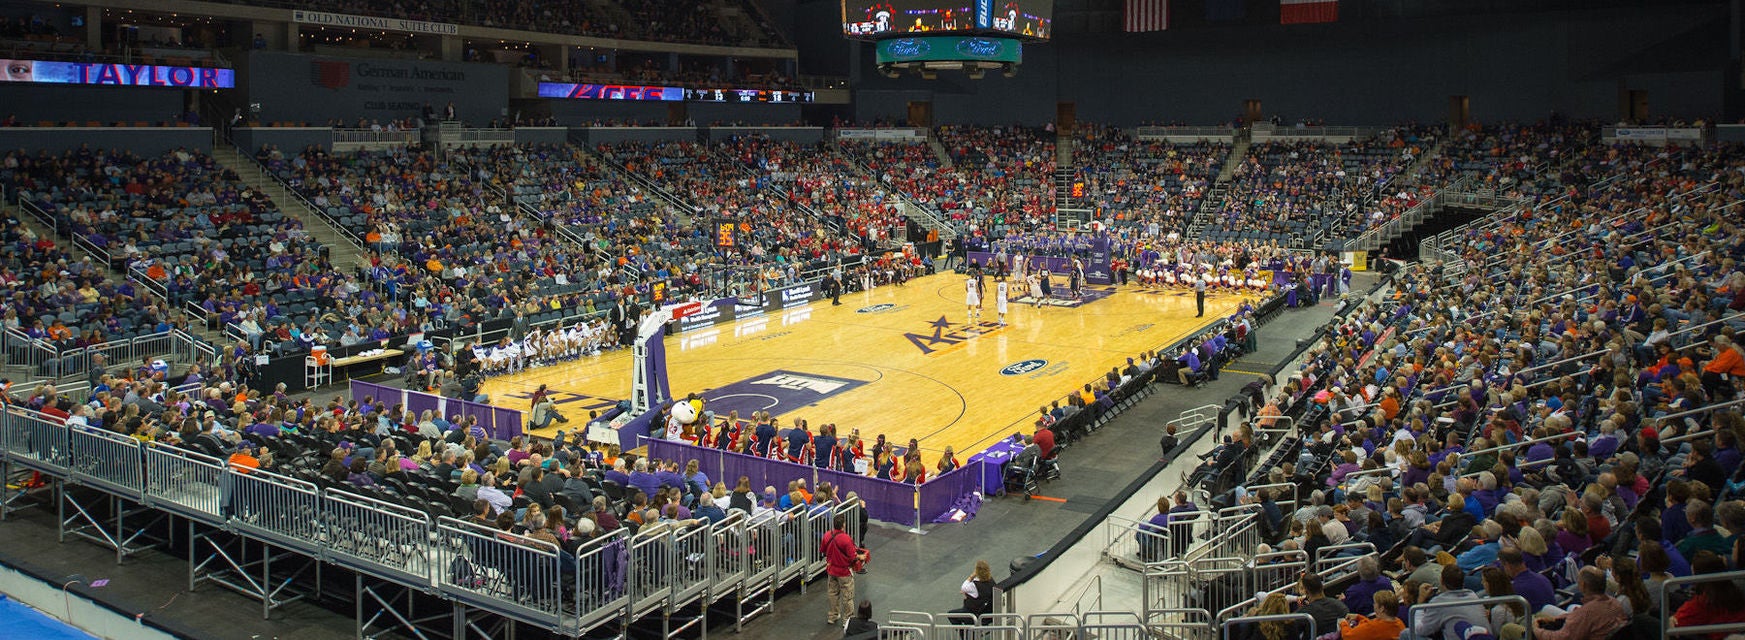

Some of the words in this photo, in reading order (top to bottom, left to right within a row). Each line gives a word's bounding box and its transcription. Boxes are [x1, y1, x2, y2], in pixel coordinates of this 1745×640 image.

[307, 12, 332, 23] OLD
[335, 14, 389, 28] NATIONAL
[399, 19, 429, 31] SUITE
[430, 22, 457, 34] CLUB
[73, 62, 218, 88] TAYLOR
[356, 62, 409, 78] German
[411, 64, 465, 81] American
[715, 93, 723, 101] 13
[364, 101, 386, 110] CLUB
[387, 101, 420, 111] SEATING
[1072, 188, 1083, 198] 35
[719, 231, 733, 246] 35
[653, 290, 663, 301] 35
